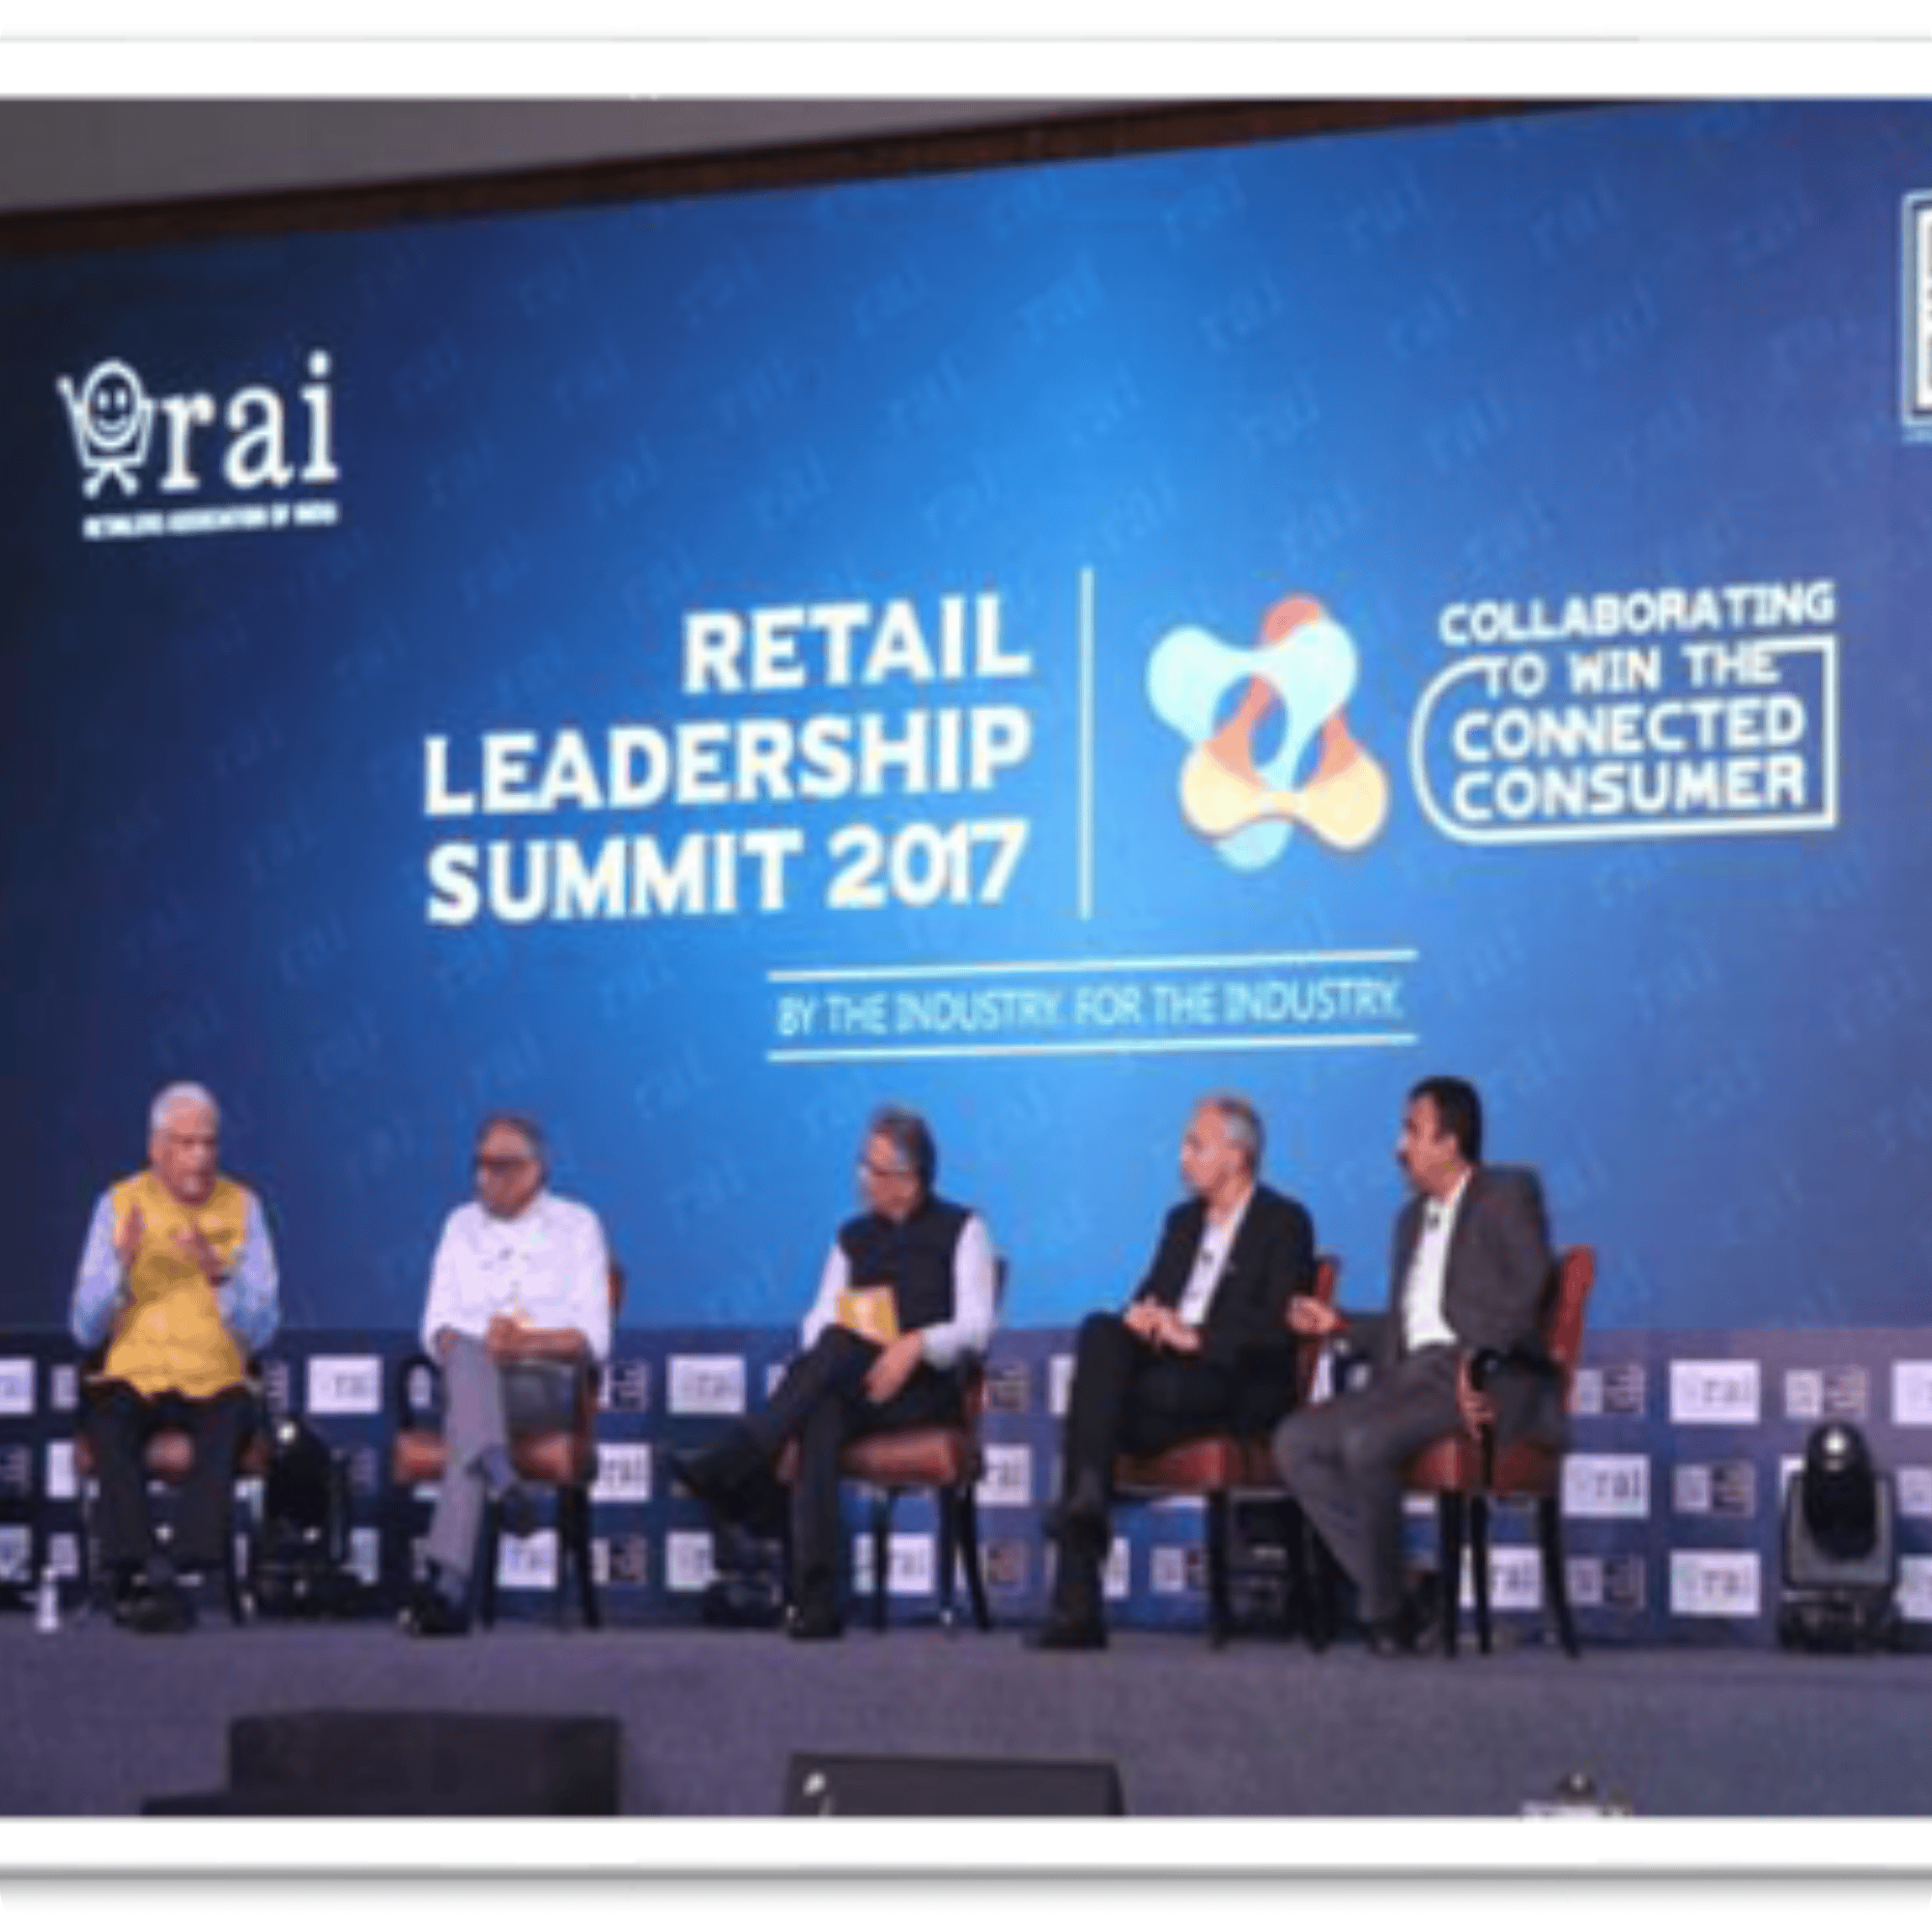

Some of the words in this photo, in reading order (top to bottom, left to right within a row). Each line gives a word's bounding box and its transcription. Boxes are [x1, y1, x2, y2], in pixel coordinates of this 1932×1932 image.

[157, 348, 340, 493] rai
[682, 592, 1033, 696] RETAIL
[1438, 581, 1836, 646] COLLABORATING
[1479, 649, 1548, 699] TO
[1567, 643, 1662, 695] WIN
[1681, 636, 1784, 688] THE
[423, 703, 1034, 817] LEADERSHIP
[1452, 692, 1807, 763] CONNECTED
[1452, 752, 1807, 822] CONSUMER
[425, 827, 804, 926] SUMMIT
[825, 816, 1031, 911] 2017
[777, 993, 813, 1036] BY
[826, 991, 888, 1034] THE
[1075, 983, 1143, 1027] FOR
[1154, 980, 1226, 1024] THE
